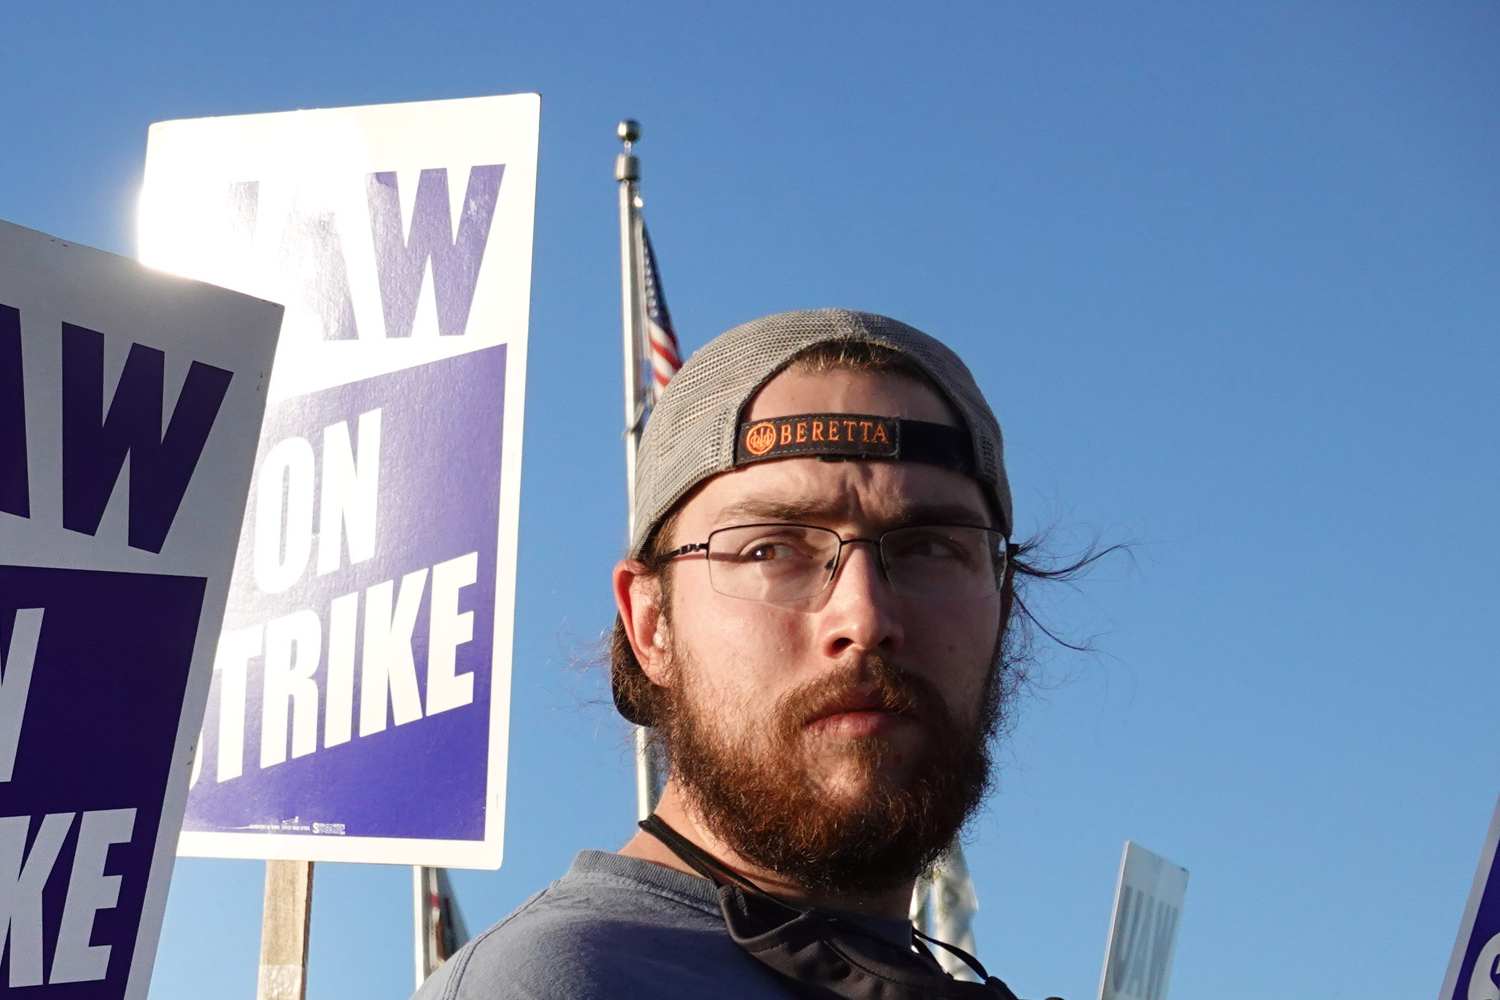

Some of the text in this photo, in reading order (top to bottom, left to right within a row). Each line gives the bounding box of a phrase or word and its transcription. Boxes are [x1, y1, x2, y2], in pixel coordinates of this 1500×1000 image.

[254, 407, 382, 595] ON
[780, 419, 889, 445] BERETTA
[190, 551, 478, 790] TRIKE
